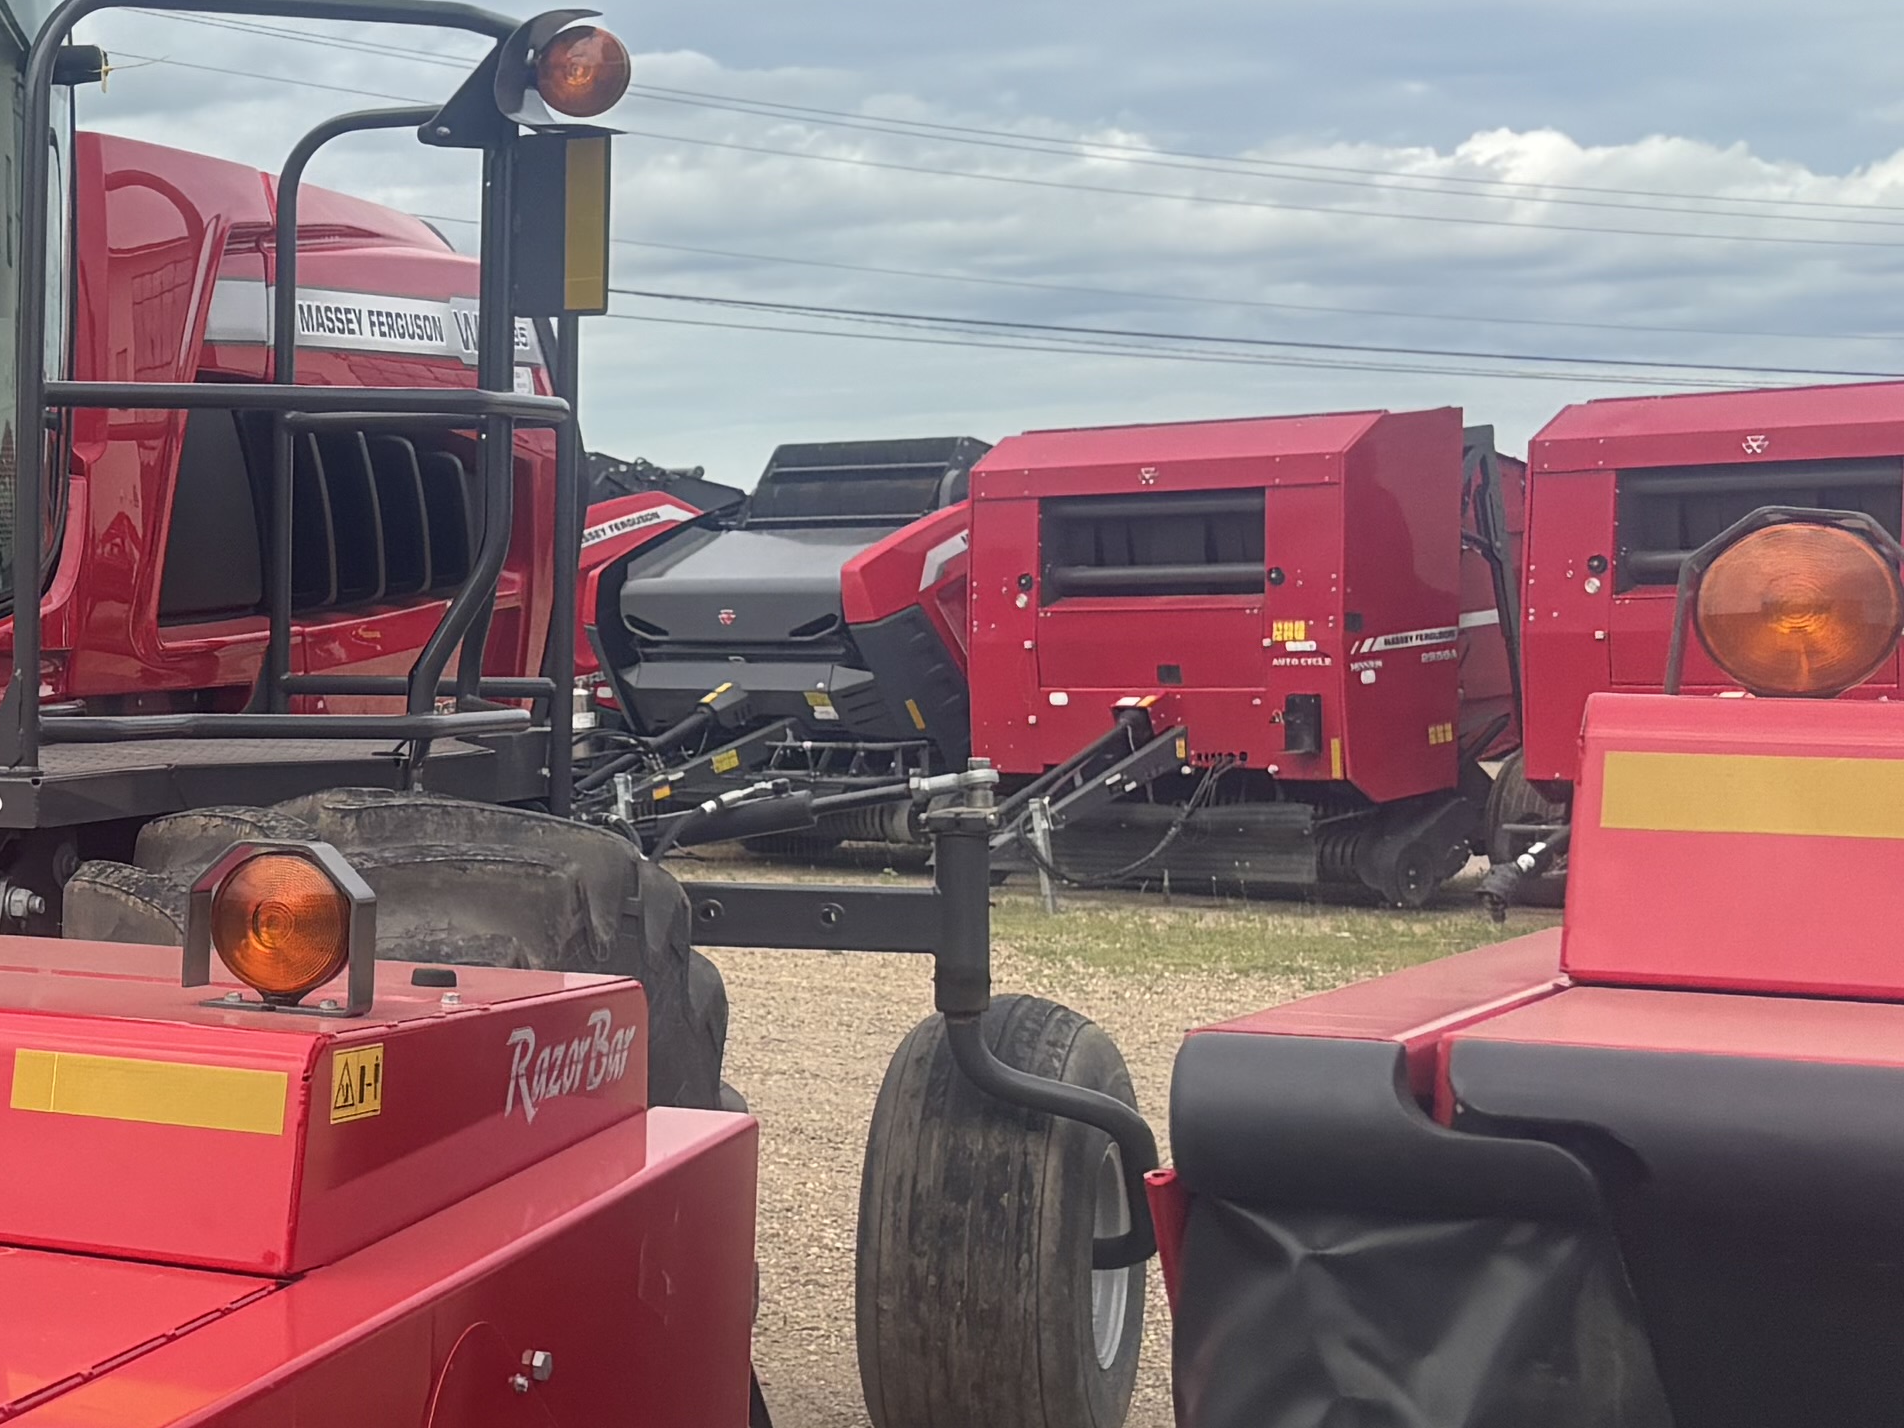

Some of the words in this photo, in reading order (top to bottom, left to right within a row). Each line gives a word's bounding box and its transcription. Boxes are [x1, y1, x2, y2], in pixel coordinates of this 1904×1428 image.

[297, 303, 364, 337] MASSEY
[367, 309, 445, 343] FERGUSON
[1272, 657, 1298, 667] AUTO
